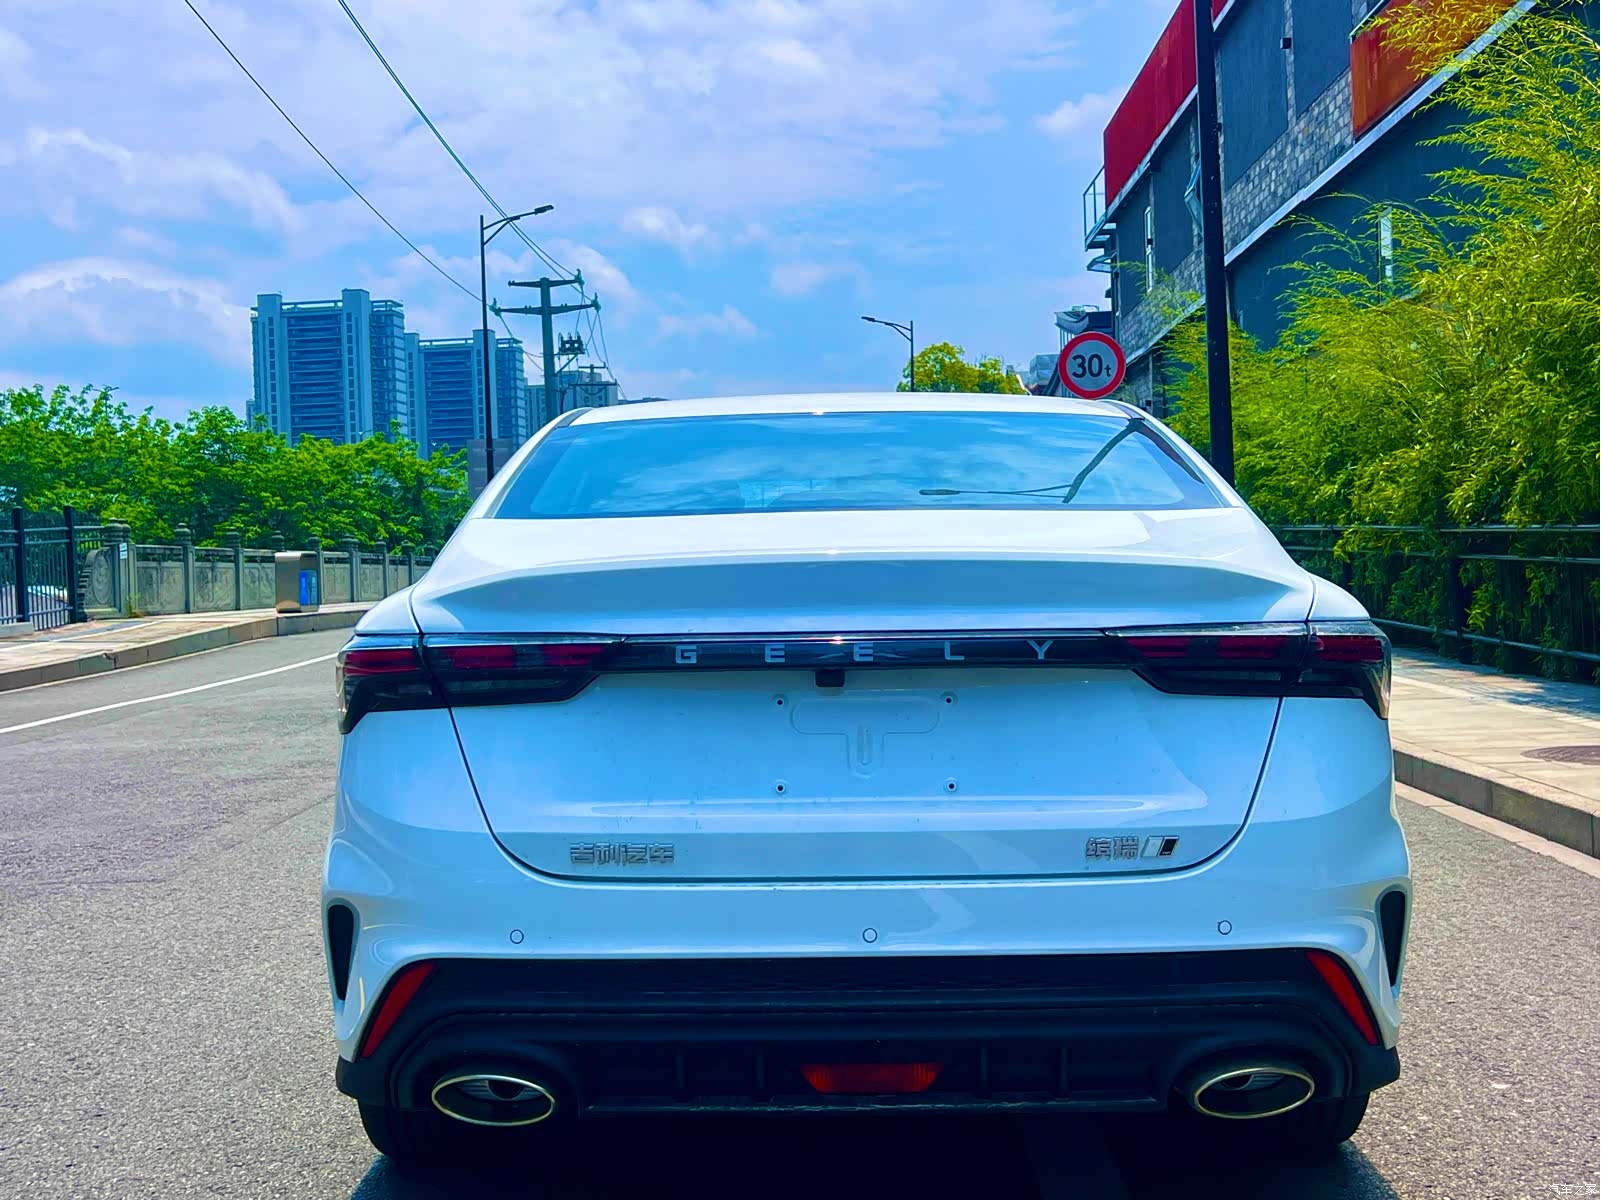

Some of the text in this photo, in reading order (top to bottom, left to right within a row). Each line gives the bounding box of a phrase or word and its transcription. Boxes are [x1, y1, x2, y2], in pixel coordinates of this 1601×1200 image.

[1072, 353, 1111, 378] 30t
[676, 640, 1053, 664] GEELY
[570, 842, 674, 866] 吉利汽车
[1086, 836, 1139, 860] 缤瑞
